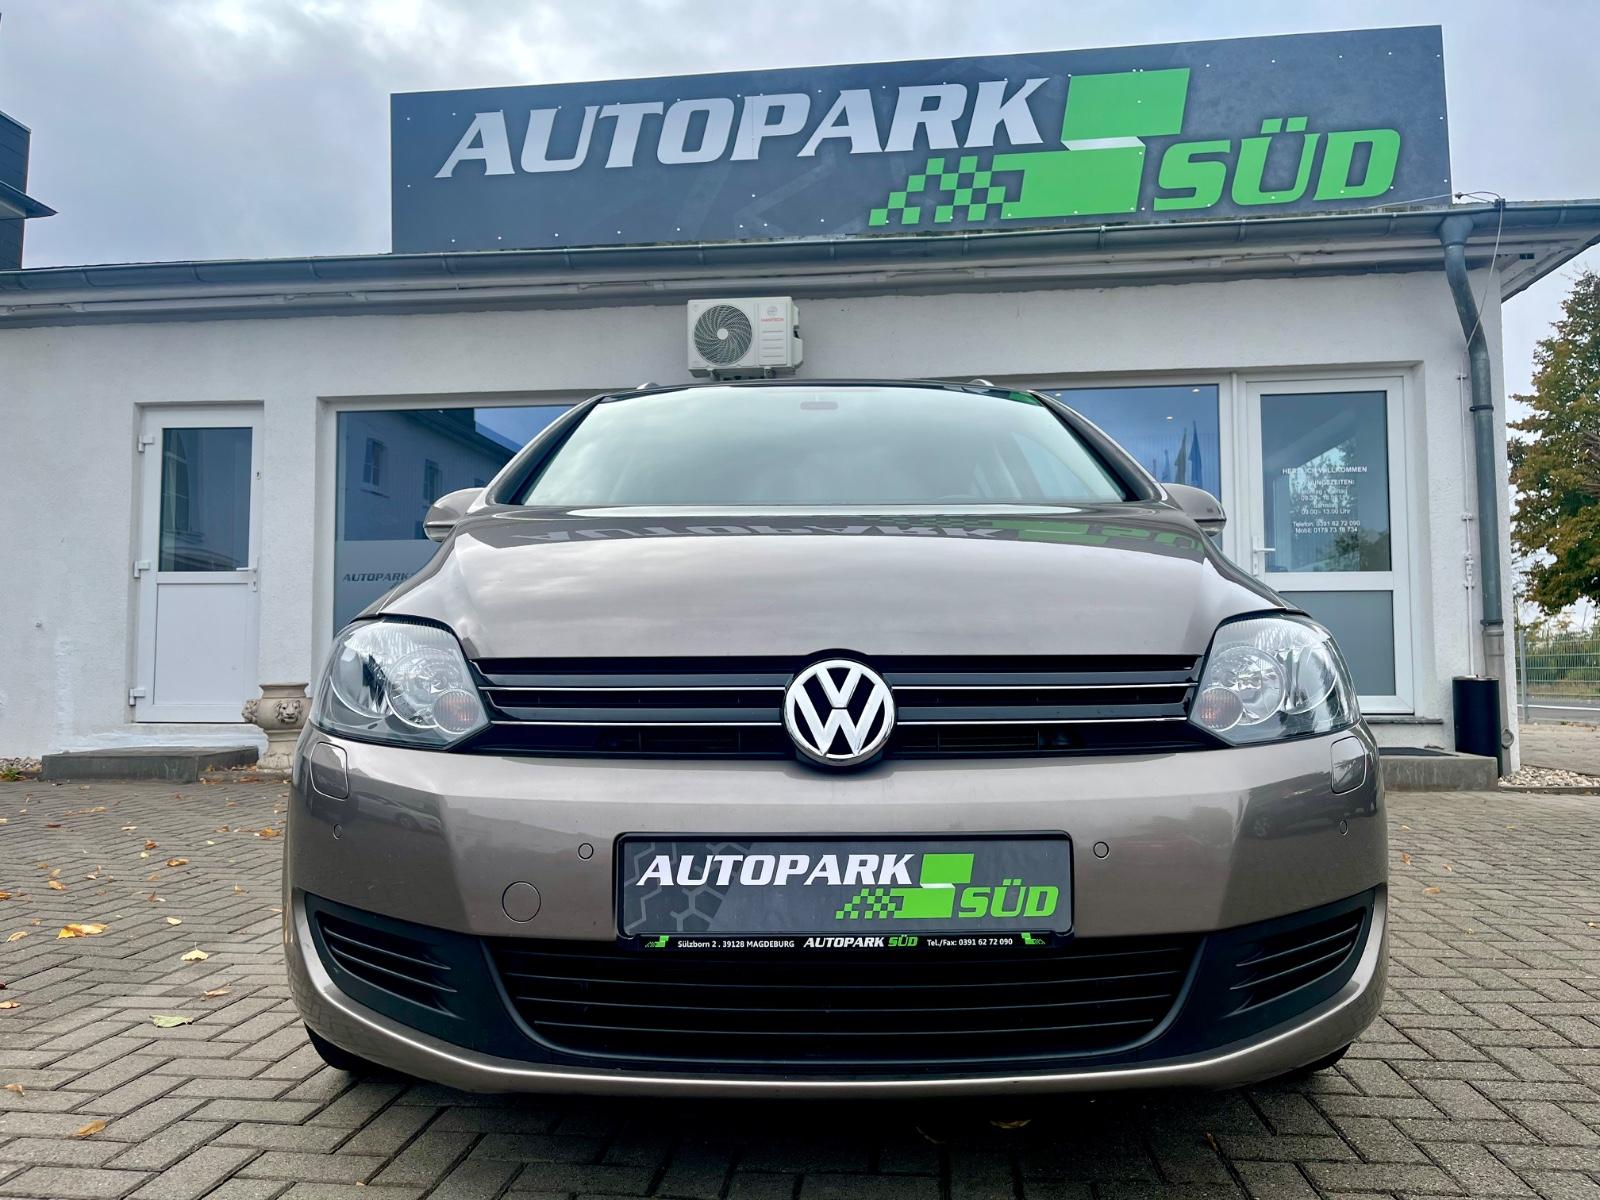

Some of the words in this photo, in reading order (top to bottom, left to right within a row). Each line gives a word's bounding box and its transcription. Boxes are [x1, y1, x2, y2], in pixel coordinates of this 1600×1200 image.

[433, 77, 1050, 179] AUTOPARK
[1153, 116, 1401, 212] SÜD
[343, 573, 409, 582] AUTOPARK
[785, 659, 895, 760] VW
[636, 853, 915, 887] AUTOPARK
[957, 879, 1059, 919] SÜD
[677, 939, 710, 948] Sülzborn
[712, 940, 717, 948] 2
[722, 940, 745, 948] 39128
[747, 940, 795, 948] MAGDEBURG
[803, 937, 885, 948] AUTOPARK
[888, 935, 919, 947] SÜD
[927, 938, 957, 947] Tel./Fax:
[959, 938, 976, 946] 0391
[978, 938, 987, 946] 62
[989, 938, 998, 946] 72
[999, 937, 1013, 946] 090
